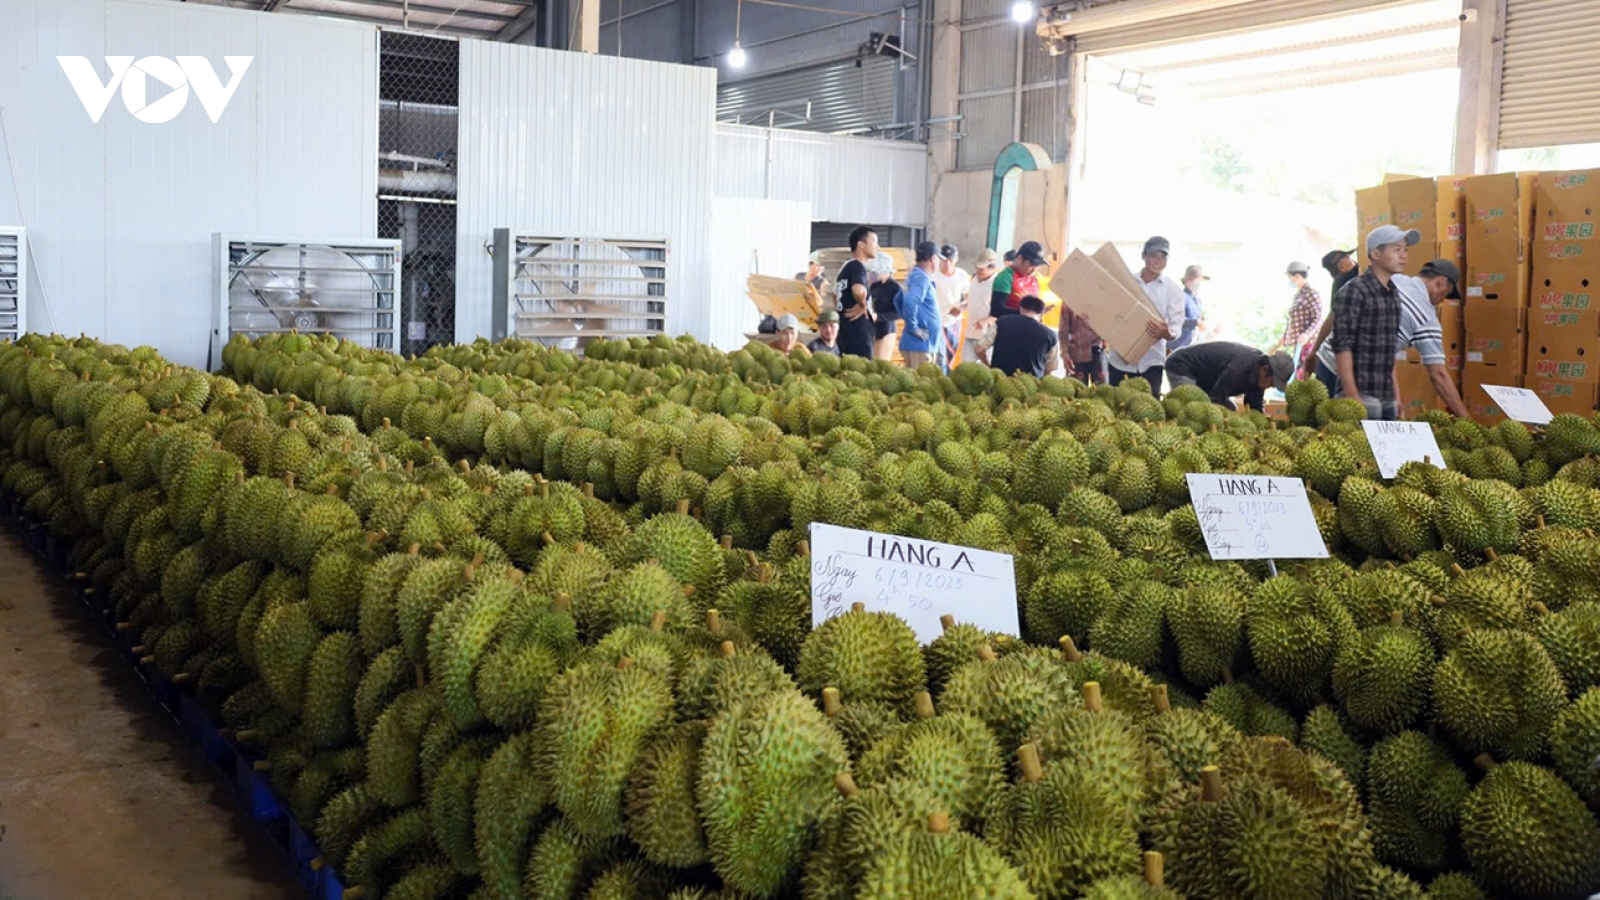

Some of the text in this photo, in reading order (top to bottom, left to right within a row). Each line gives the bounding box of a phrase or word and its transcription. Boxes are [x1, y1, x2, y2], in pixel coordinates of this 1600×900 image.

[1544, 222, 1594, 239] 10号果园
[1540, 292, 1591, 309] 10号果园
[1536, 360, 1585, 378] 10号果园
[1267, 478, 1281, 494] A
[950, 551, 976, 573] A
